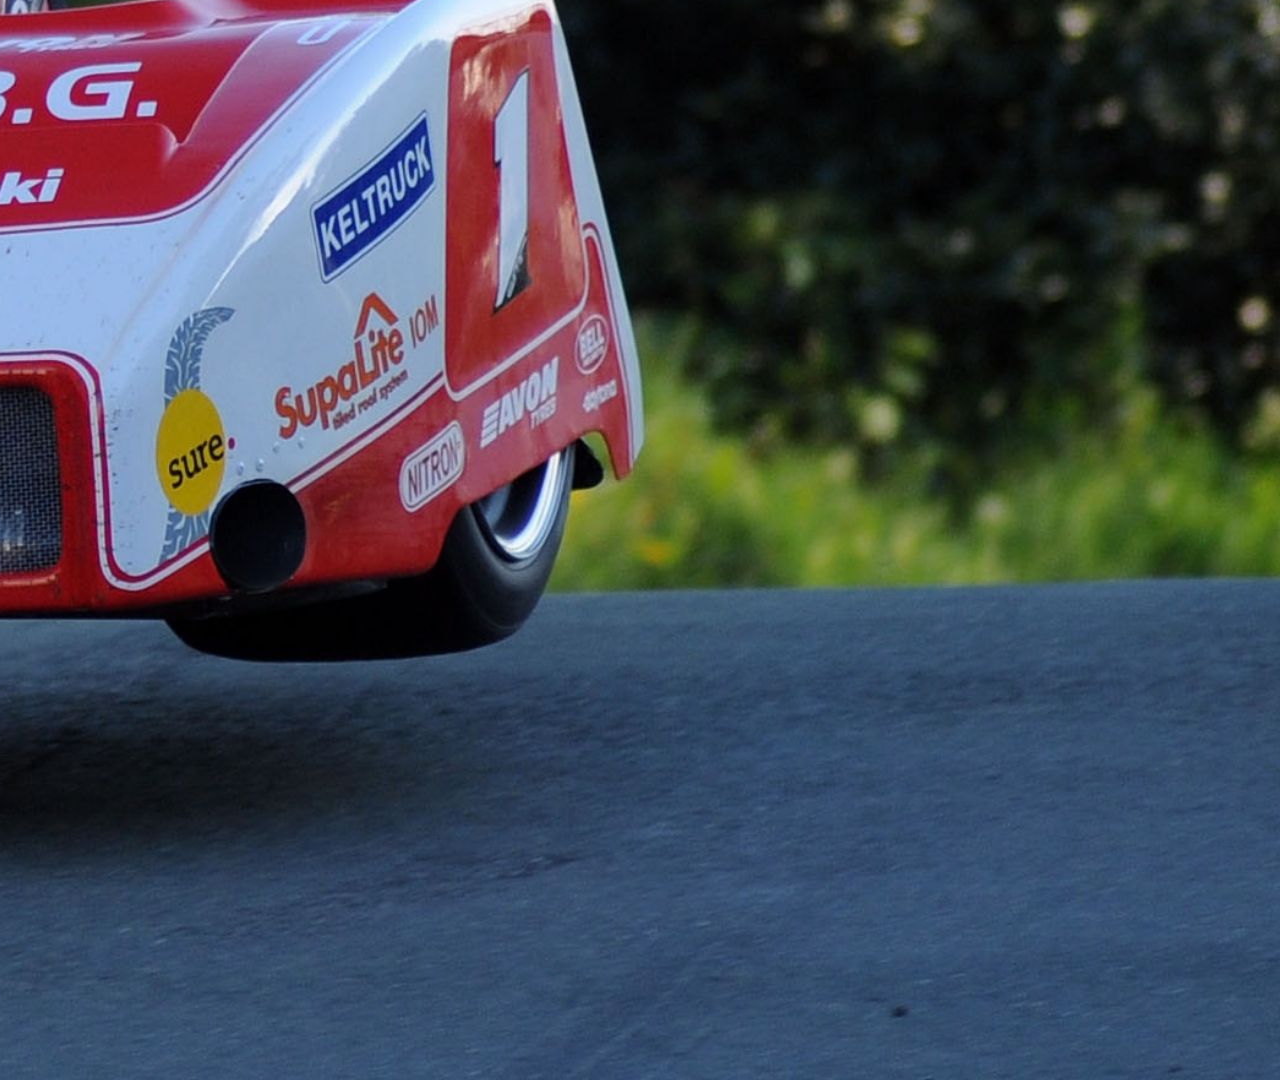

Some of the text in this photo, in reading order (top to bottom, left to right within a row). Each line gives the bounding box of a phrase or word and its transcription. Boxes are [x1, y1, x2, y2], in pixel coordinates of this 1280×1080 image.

[320, 136, 431, 258] KELTRUCK
[493, 67, 530, 312] 1
[409, 294, 439, 349] IOM
[407, 439, 458, 501] NITRON
